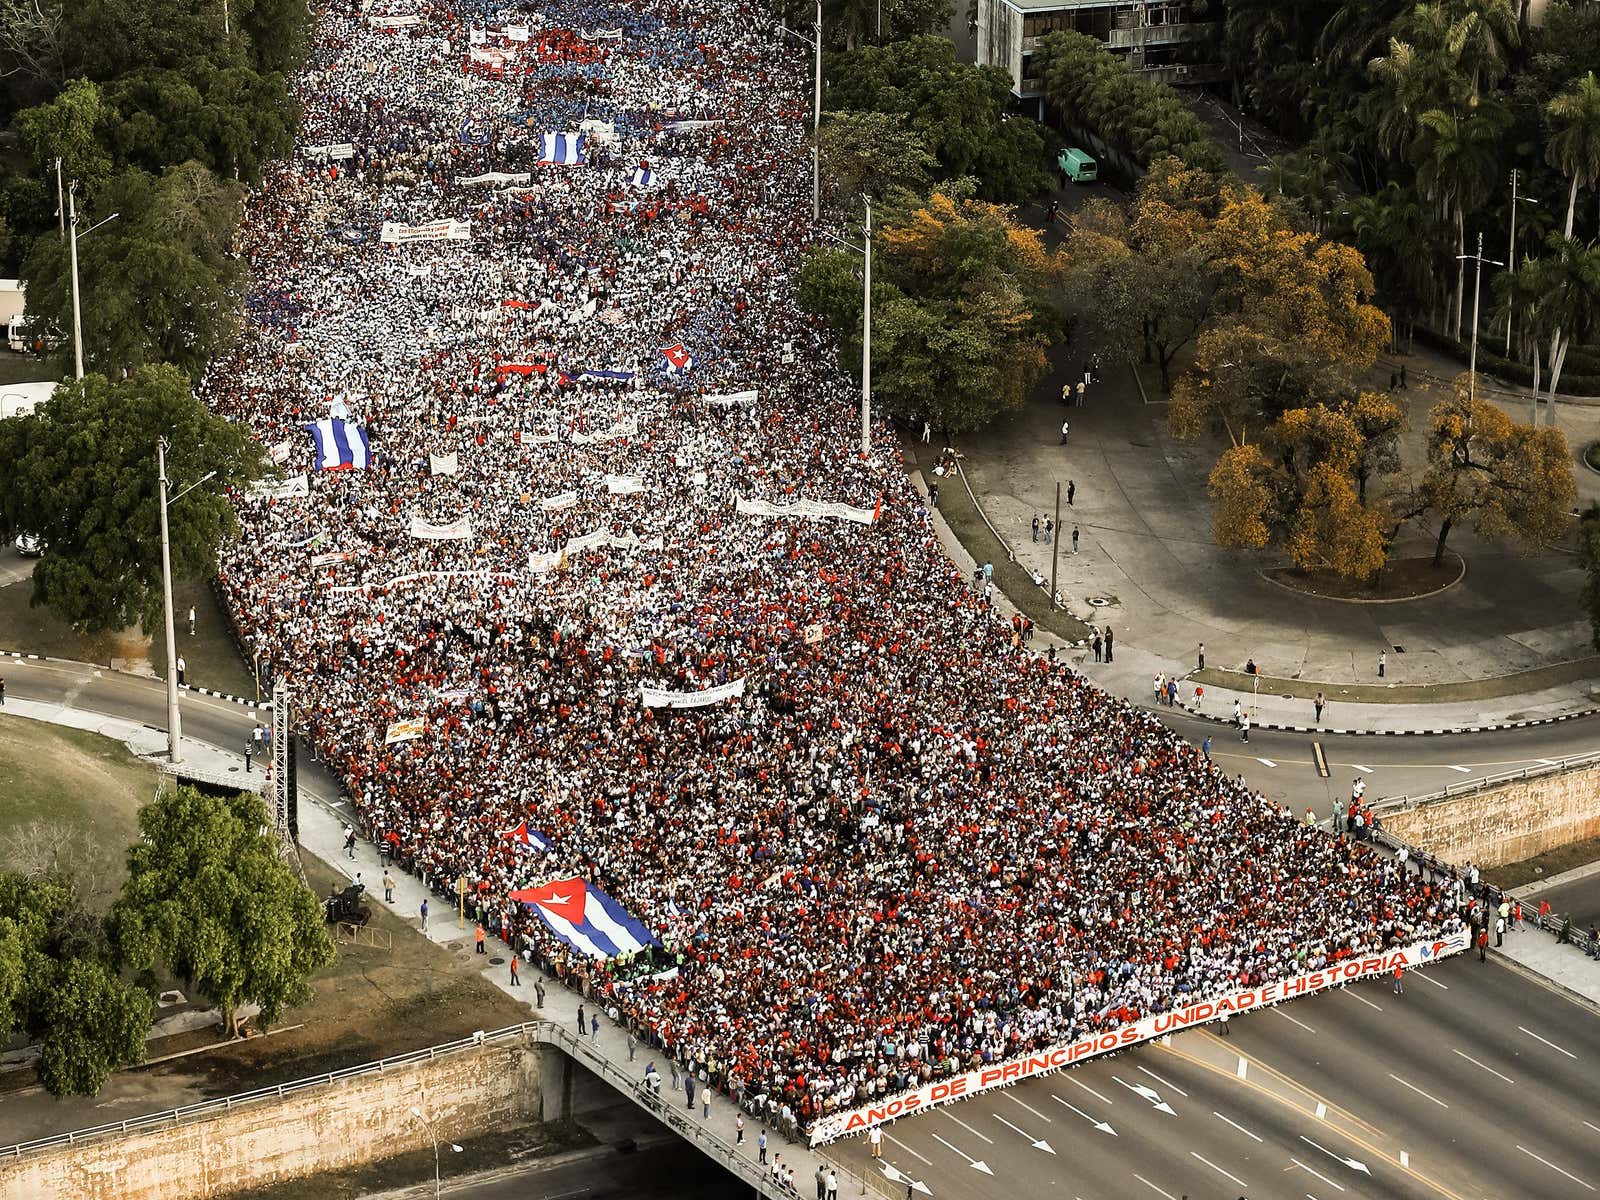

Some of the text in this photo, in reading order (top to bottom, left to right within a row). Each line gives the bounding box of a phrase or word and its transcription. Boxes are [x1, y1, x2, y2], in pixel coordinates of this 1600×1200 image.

[845, 1095, 921, 1131] AÑOS
[931, 1077, 967, 1101] DE
[1154, 993, 1255, 1033] UNIDAD
[1261, 984, 1277, 1003] E
[1283, 952, 1409, 996] HISTORIA
